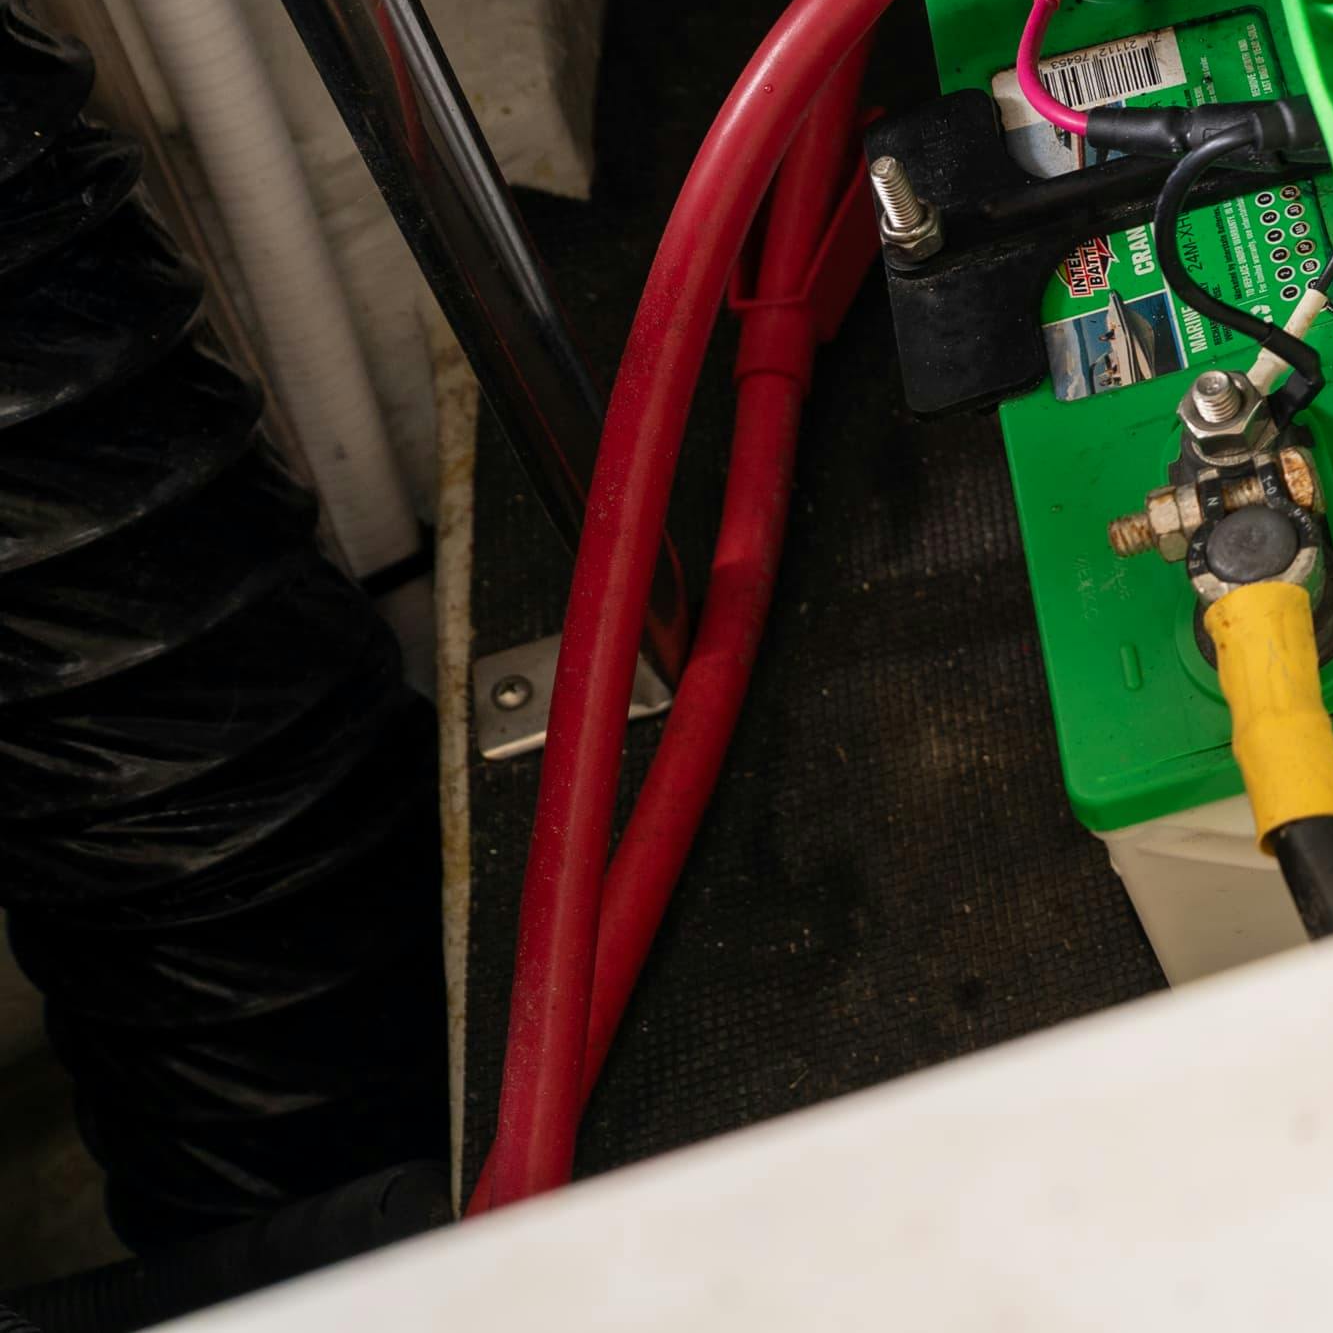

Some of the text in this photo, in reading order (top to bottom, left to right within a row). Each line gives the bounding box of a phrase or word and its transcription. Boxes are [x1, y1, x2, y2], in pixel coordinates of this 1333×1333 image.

[1097, 39, 1137, 57] 21112
[1049, 53, 1090, 69] 76453
[1181, 306, 1206, 352] MARINE
